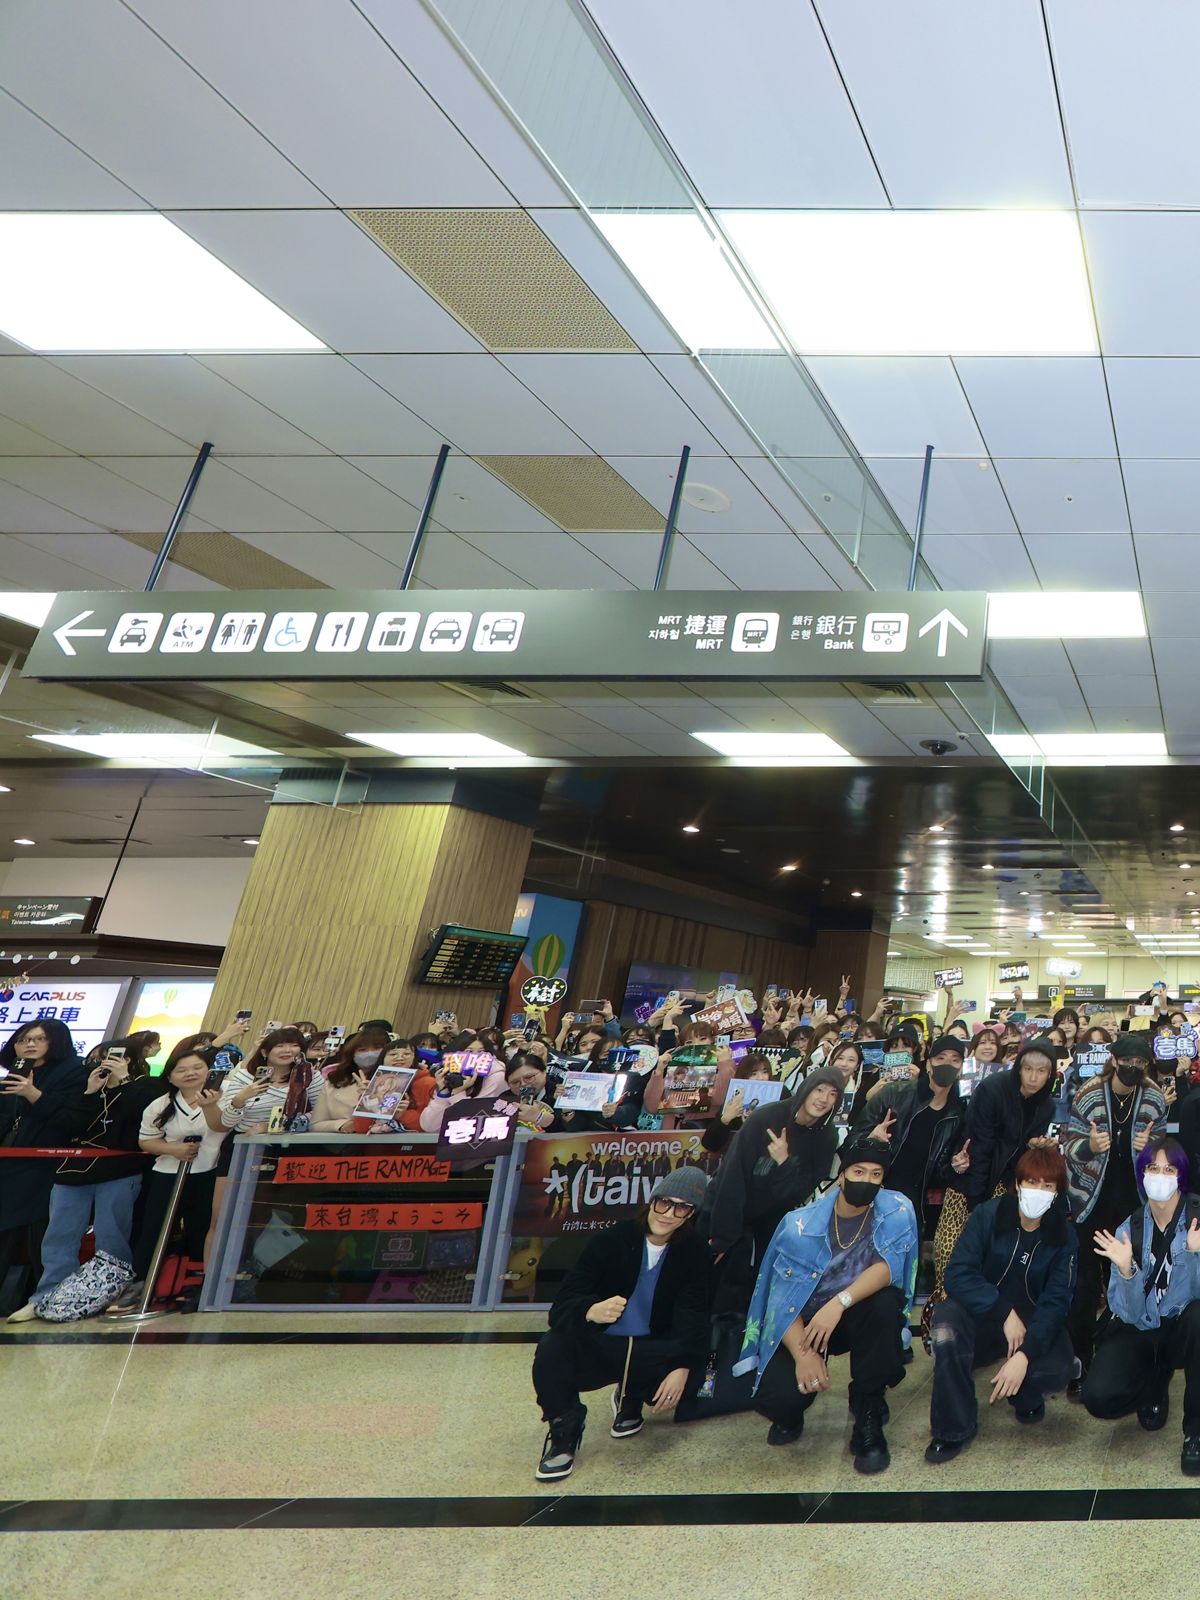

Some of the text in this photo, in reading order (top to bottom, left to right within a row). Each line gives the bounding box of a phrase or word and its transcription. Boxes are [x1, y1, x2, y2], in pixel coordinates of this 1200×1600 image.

[658, 615, 682, 625] MRT
[684, 614, 727, 635] 捷運
[815, 615, 857, 635] 銀行
[648, 629, 680, 640] 지하철
[791, 629, 811, 640] 은행
[695, 639, 723, 649] MRT
[824, 639, 855, 649] Bank
[19, 992, 86, 1001] CARPLUS
[527, 983, 560, 1003] 樹
[1077, 1053, 1088, 1064] THE
[591, 1137, 682, 1156] welcome
[282, 1157, 449, 1181] 歡迎 THE RAMPAGE
